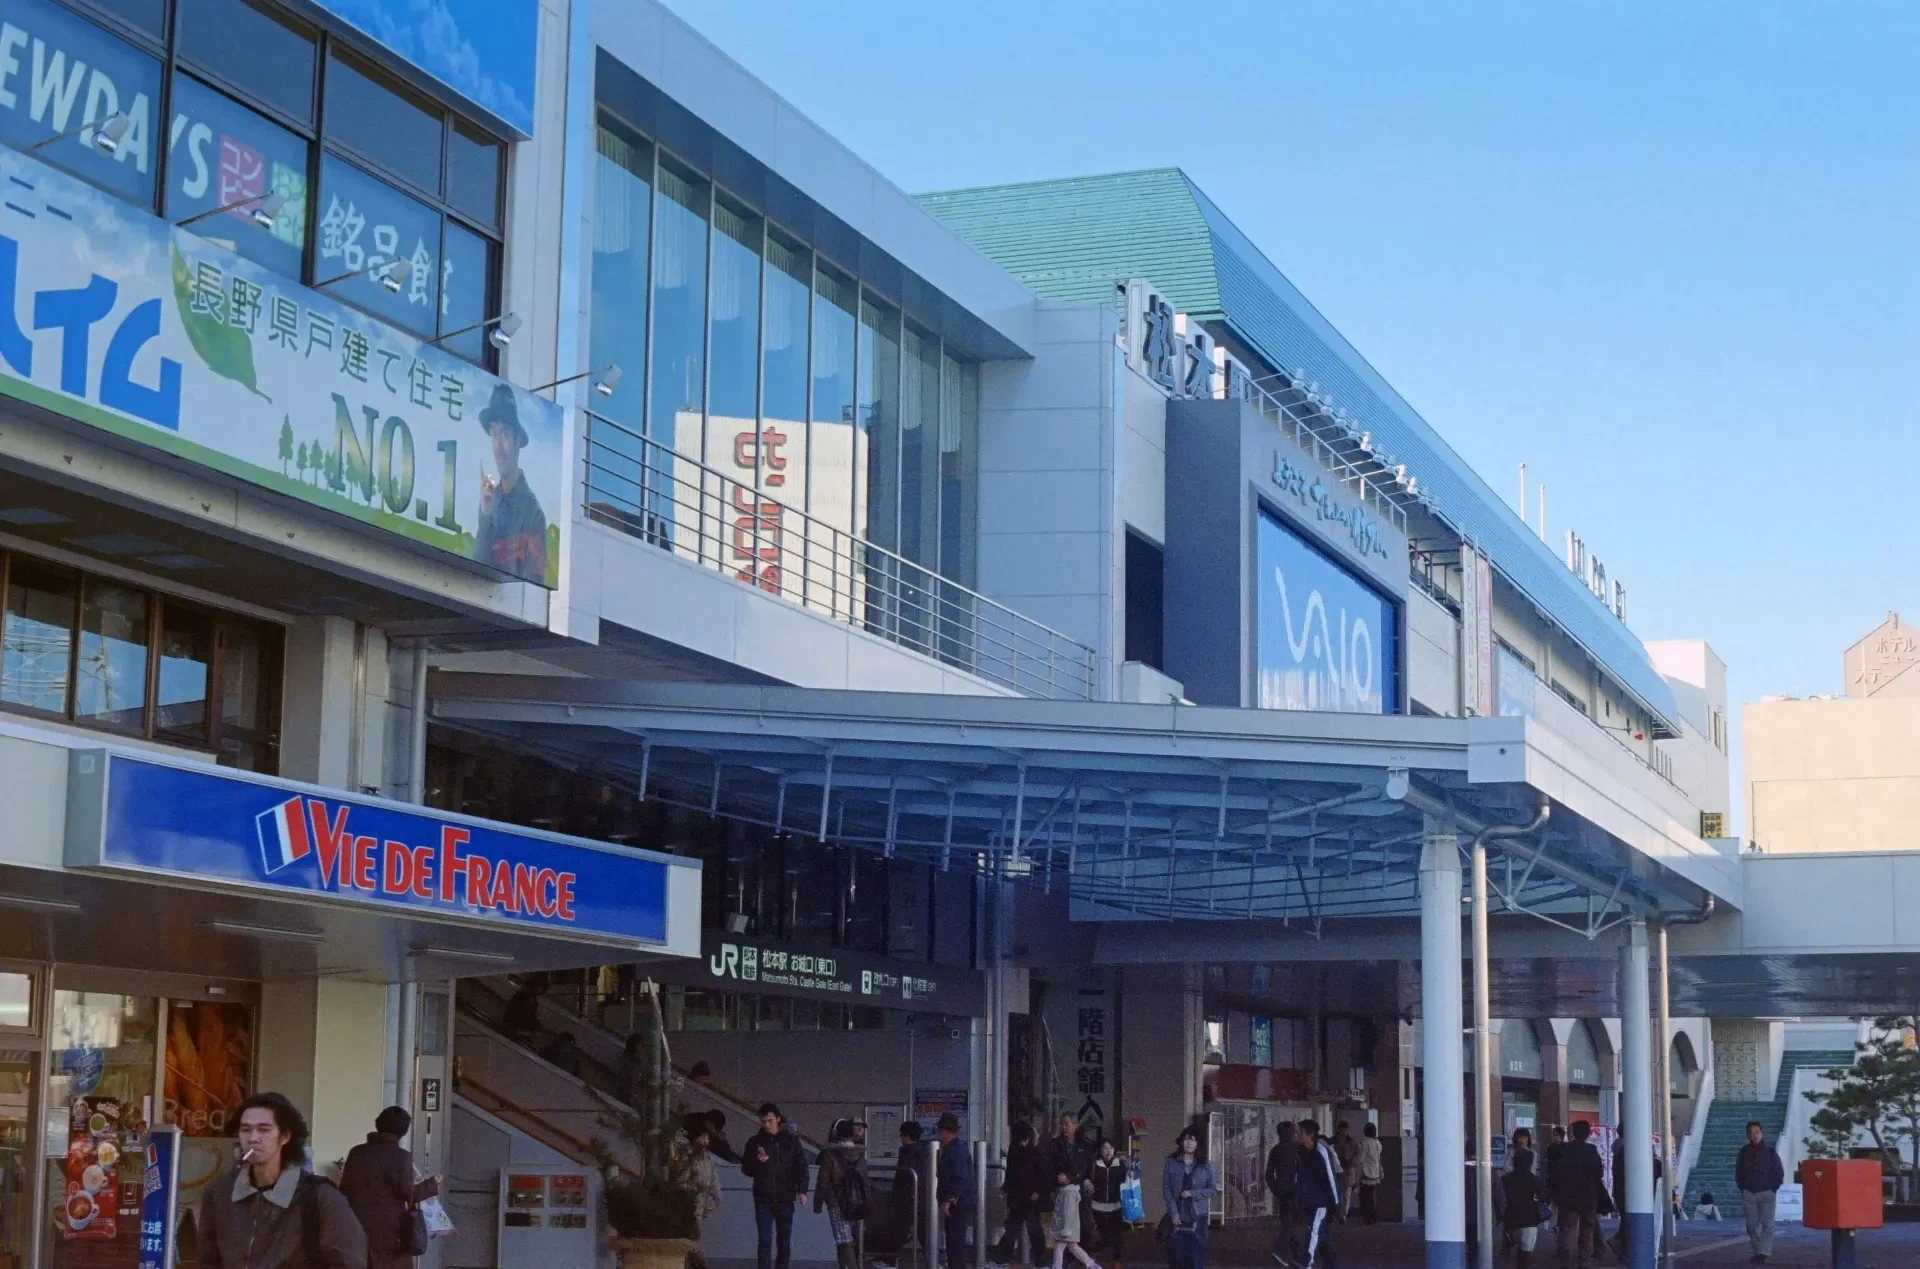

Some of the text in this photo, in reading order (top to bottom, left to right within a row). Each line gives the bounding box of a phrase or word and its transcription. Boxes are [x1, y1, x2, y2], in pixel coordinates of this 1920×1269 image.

[222, 141, 262, 180] コン
[191, 261, 465, 422] 長野県戸建て住宅
[329, 392, 462, 533] NO.1
[1275, 566, 1373, 703] VAIO
[1876, 637, 1917, 653] ホテル
[308, 799, 576, 921] VIE DE FRANCE
[711, 943, 738, 979] JR
[763, 949, 787, 970] 松本駅
